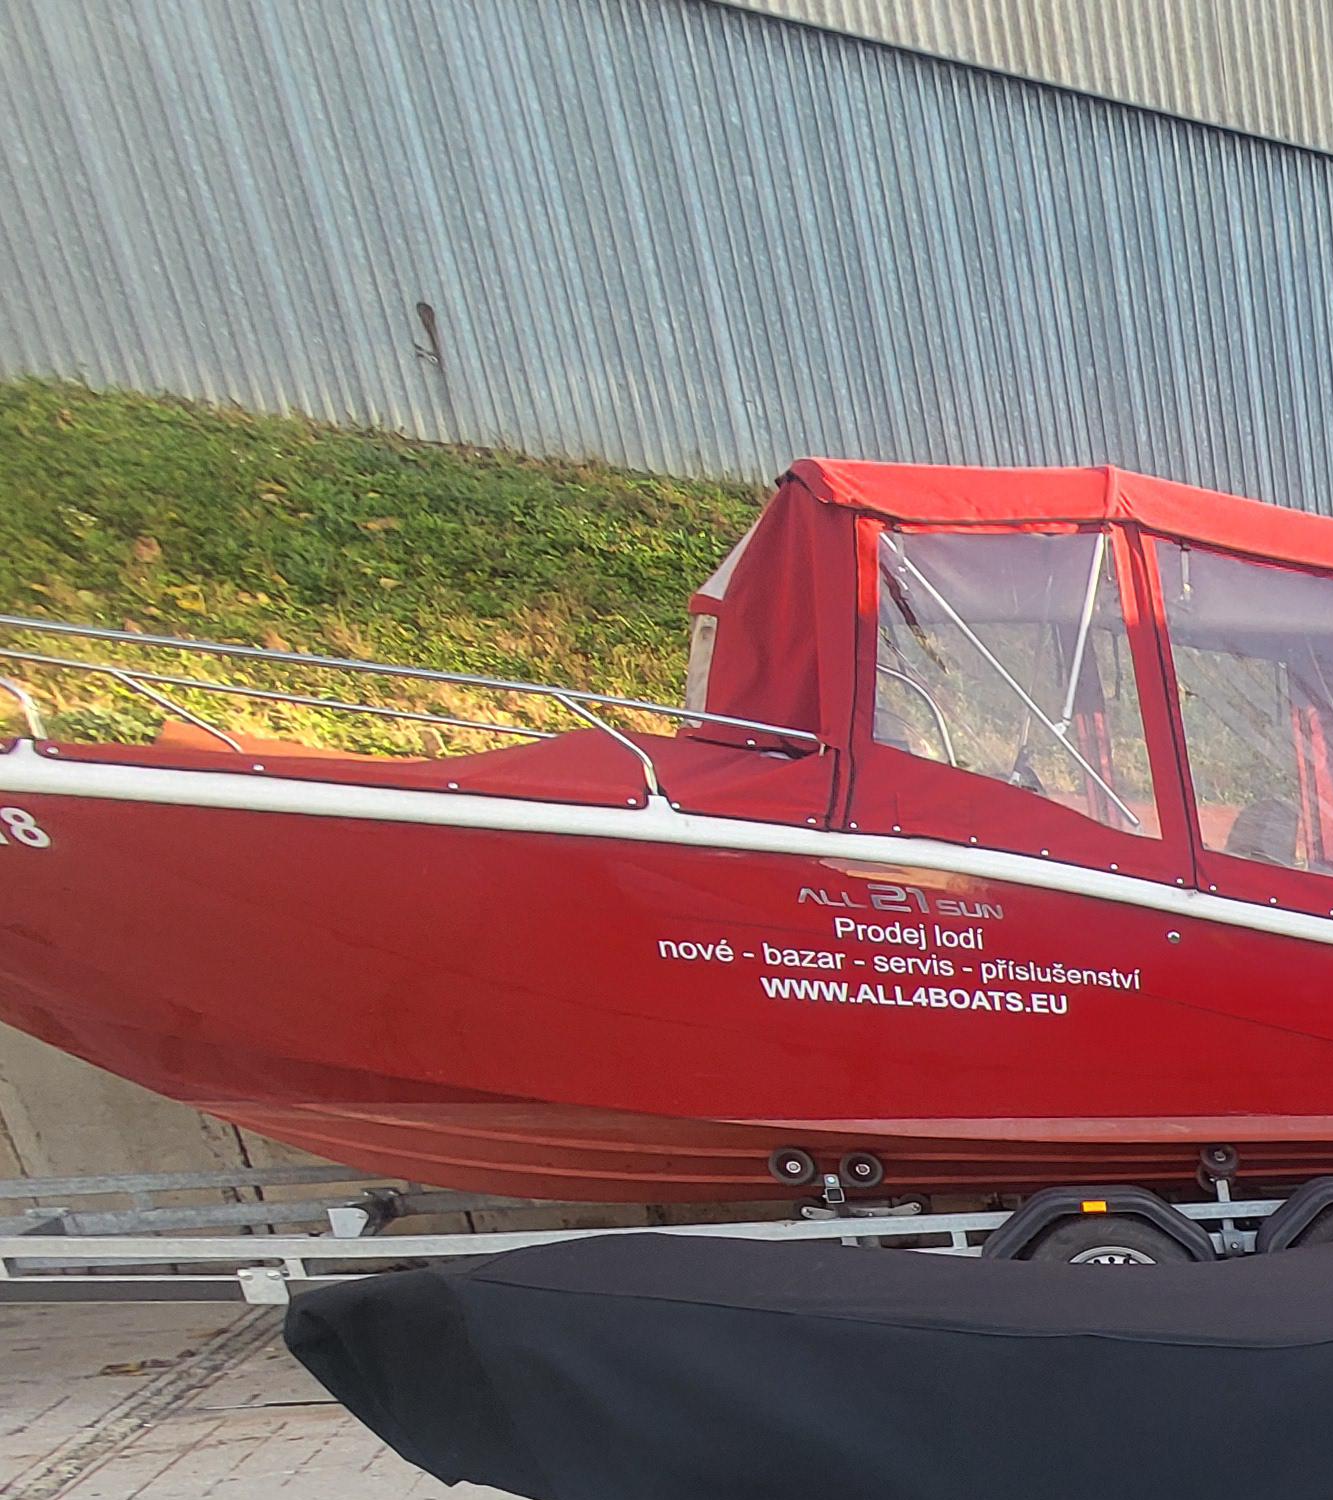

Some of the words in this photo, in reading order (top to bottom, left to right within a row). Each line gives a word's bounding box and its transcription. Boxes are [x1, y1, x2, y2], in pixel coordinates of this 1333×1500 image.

[0, 807, 50, 848] 8
[798, 886, 867, 909] ALL
[867, 883, 931, 914] 21
[935, 900, 1004, 921] SUN
[834, 917, 927, 951] Prodej
[935, 924, 984, 950] lodí
[657, 938, 735, 963] nové
[762, 942, 846, 970] bazar
[873, 954, 955, 977] servis
[980, 959, 1142, 990] příslušenství
[759, 976, 1068, 1015] WWW.ALL4BOATS.EU
